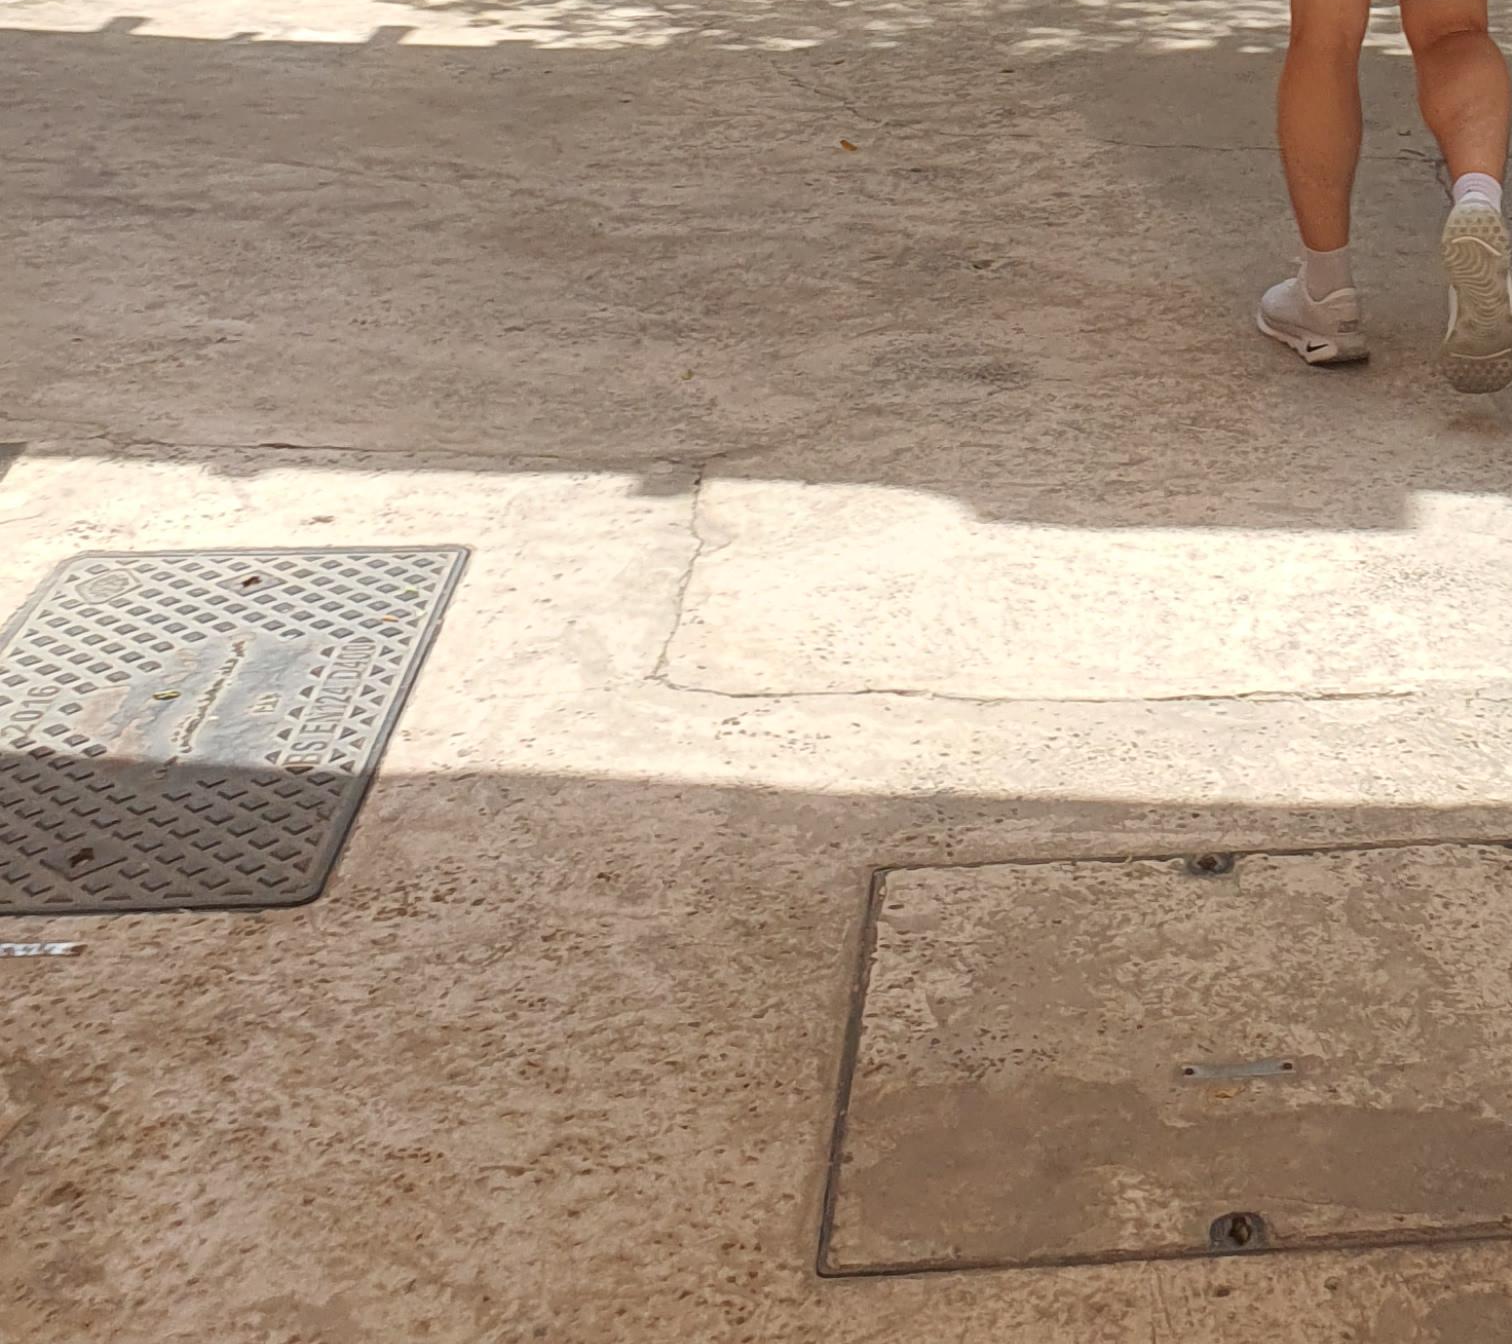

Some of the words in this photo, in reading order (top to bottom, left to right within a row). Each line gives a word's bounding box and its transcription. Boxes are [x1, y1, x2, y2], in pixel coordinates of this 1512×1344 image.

[1, 685, 61, 737] 2016
[281, 740, 328, 766] BS
[326, 643, 377, 680] D400
